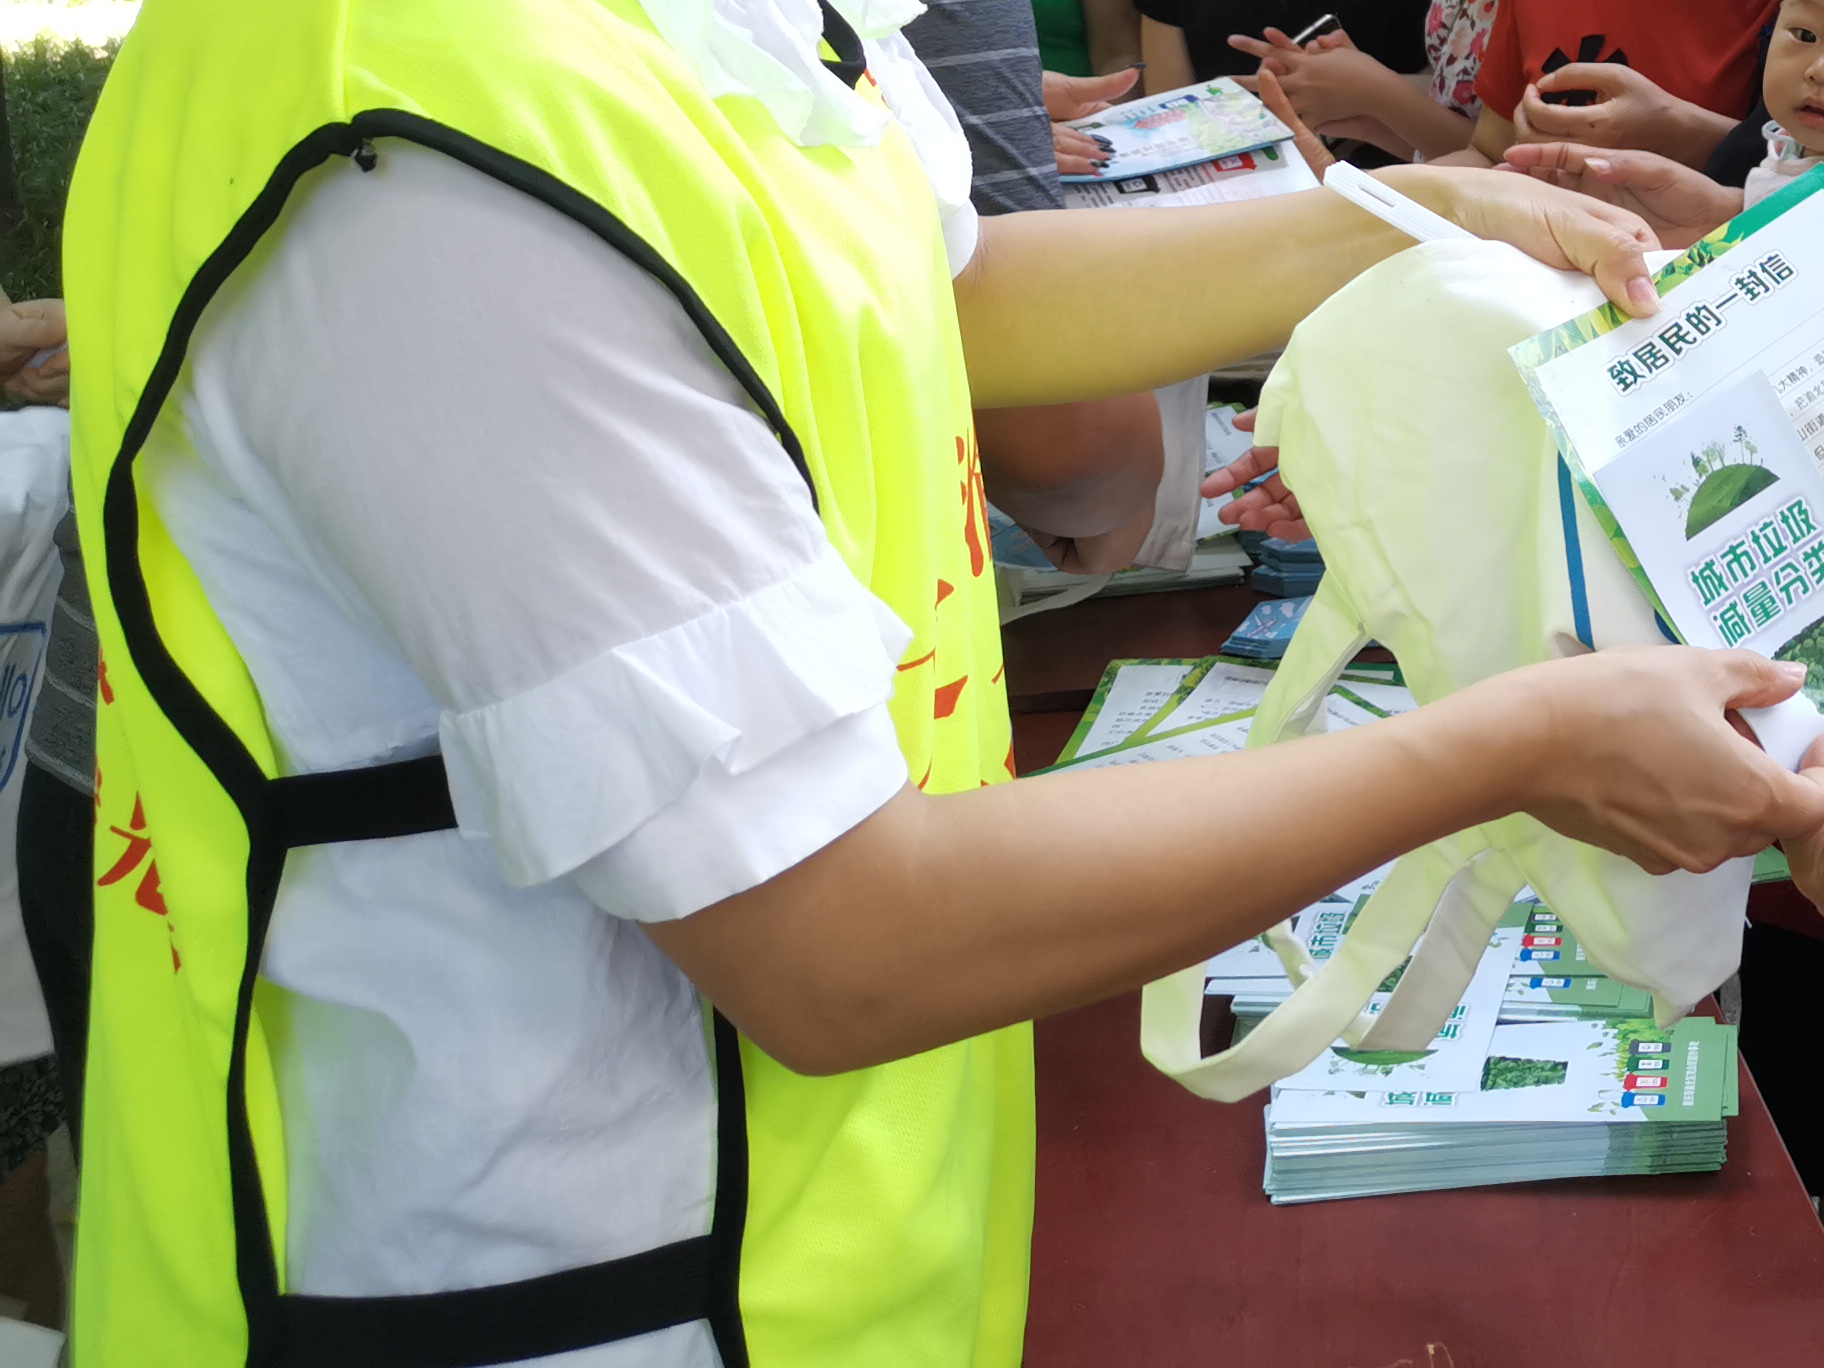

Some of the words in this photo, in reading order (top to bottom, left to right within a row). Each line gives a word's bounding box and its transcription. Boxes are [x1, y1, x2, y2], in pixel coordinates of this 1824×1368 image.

[1607, 253, 1795, 393] 致居民的一封信
[1691, 499, 1817, 606] 城市垃圾
